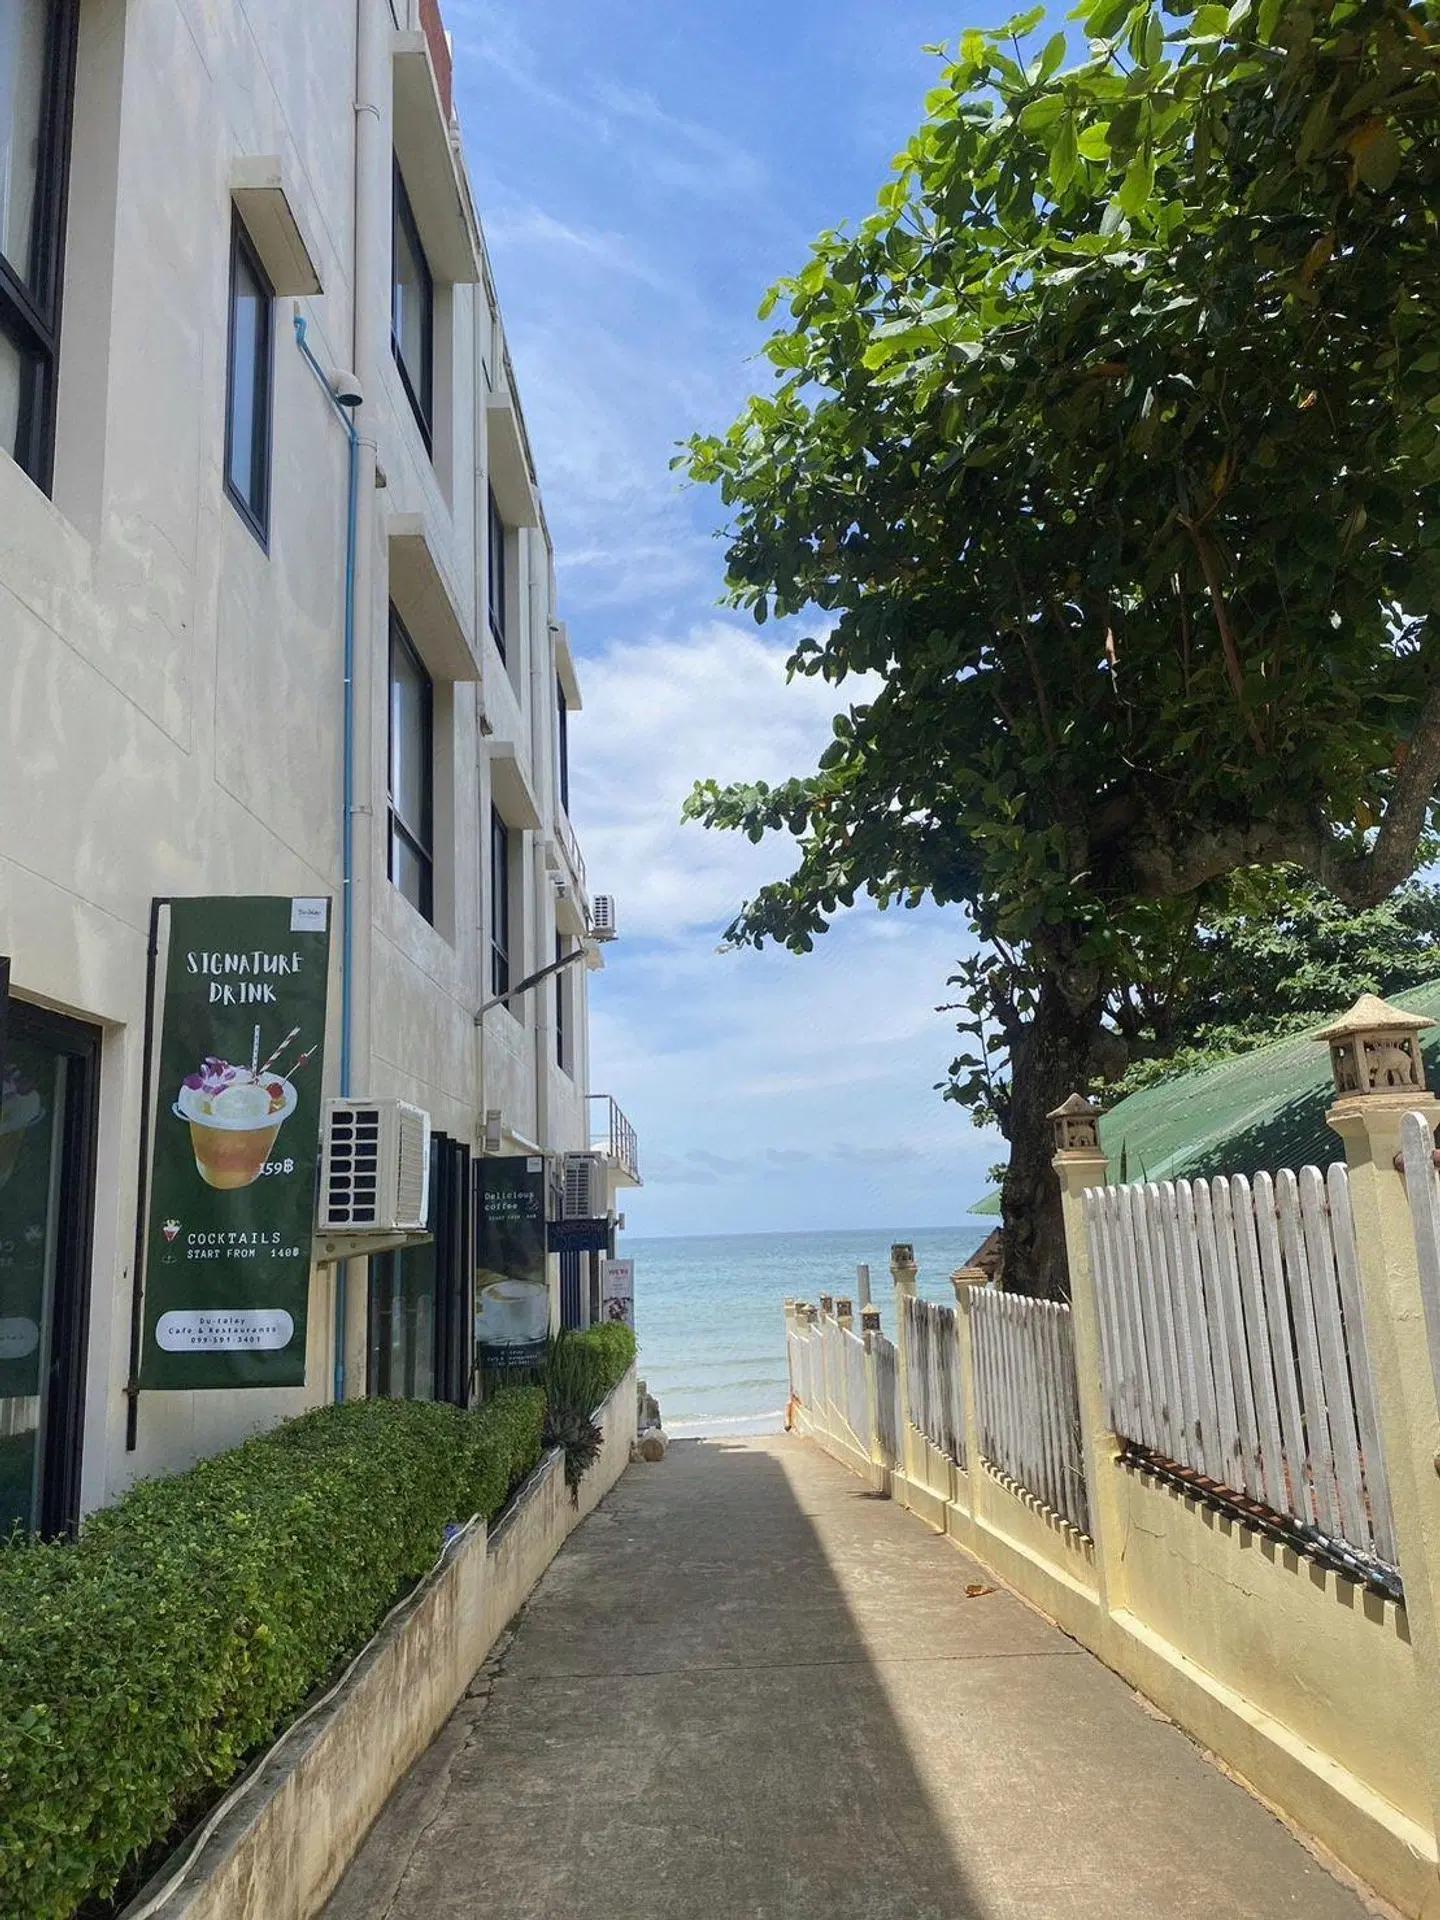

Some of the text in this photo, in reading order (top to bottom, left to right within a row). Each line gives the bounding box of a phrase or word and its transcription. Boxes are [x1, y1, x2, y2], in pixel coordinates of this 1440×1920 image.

[186, 950, 305, 975] SIGNATURE
[209, 981, 277, 1005] DRINK
[187, 1232, 281, 1245] COCKTAILS
[187, 1249, 220, 1259] START
[227, 1248, 256, 1258] FROM
